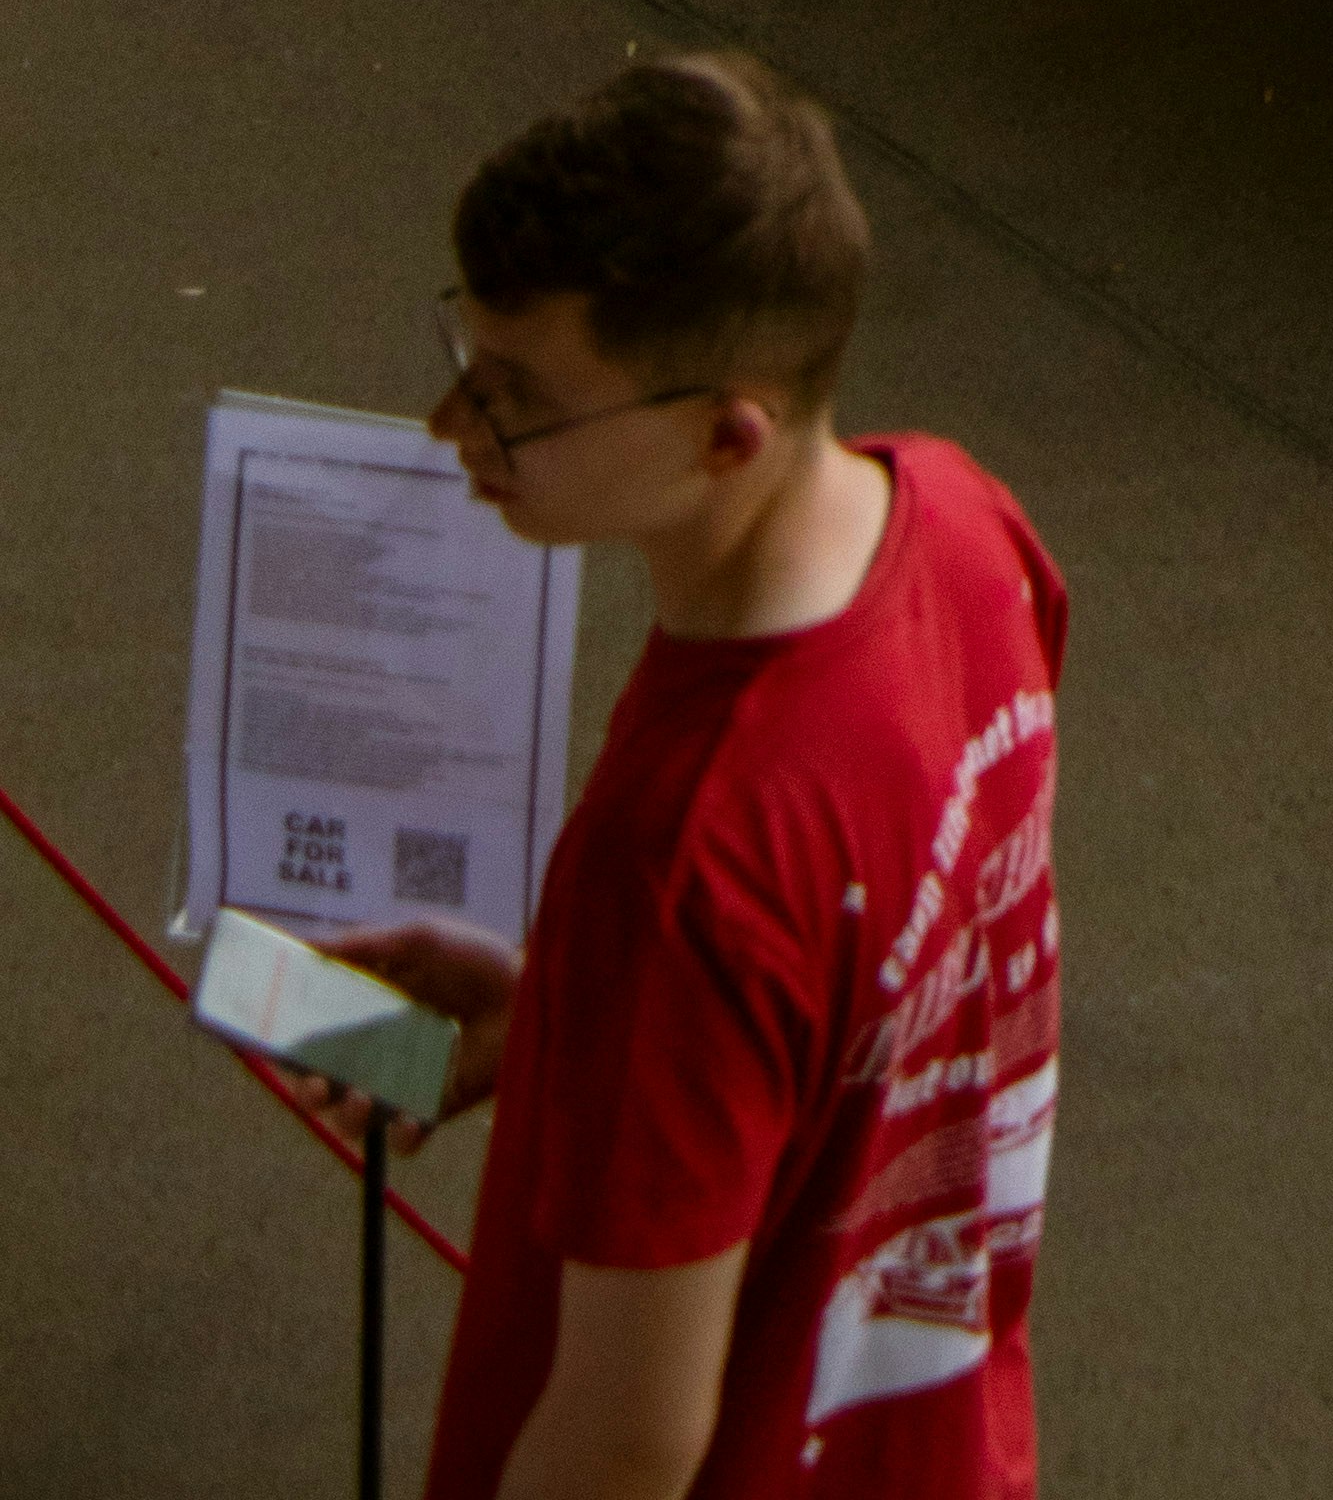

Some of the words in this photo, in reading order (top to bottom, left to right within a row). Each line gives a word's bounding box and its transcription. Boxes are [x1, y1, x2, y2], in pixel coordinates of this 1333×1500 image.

[283, 811, 346, 837] CAR
[284, 837, 345, 864] FOR
[277, 861, 351, 892] SALE
